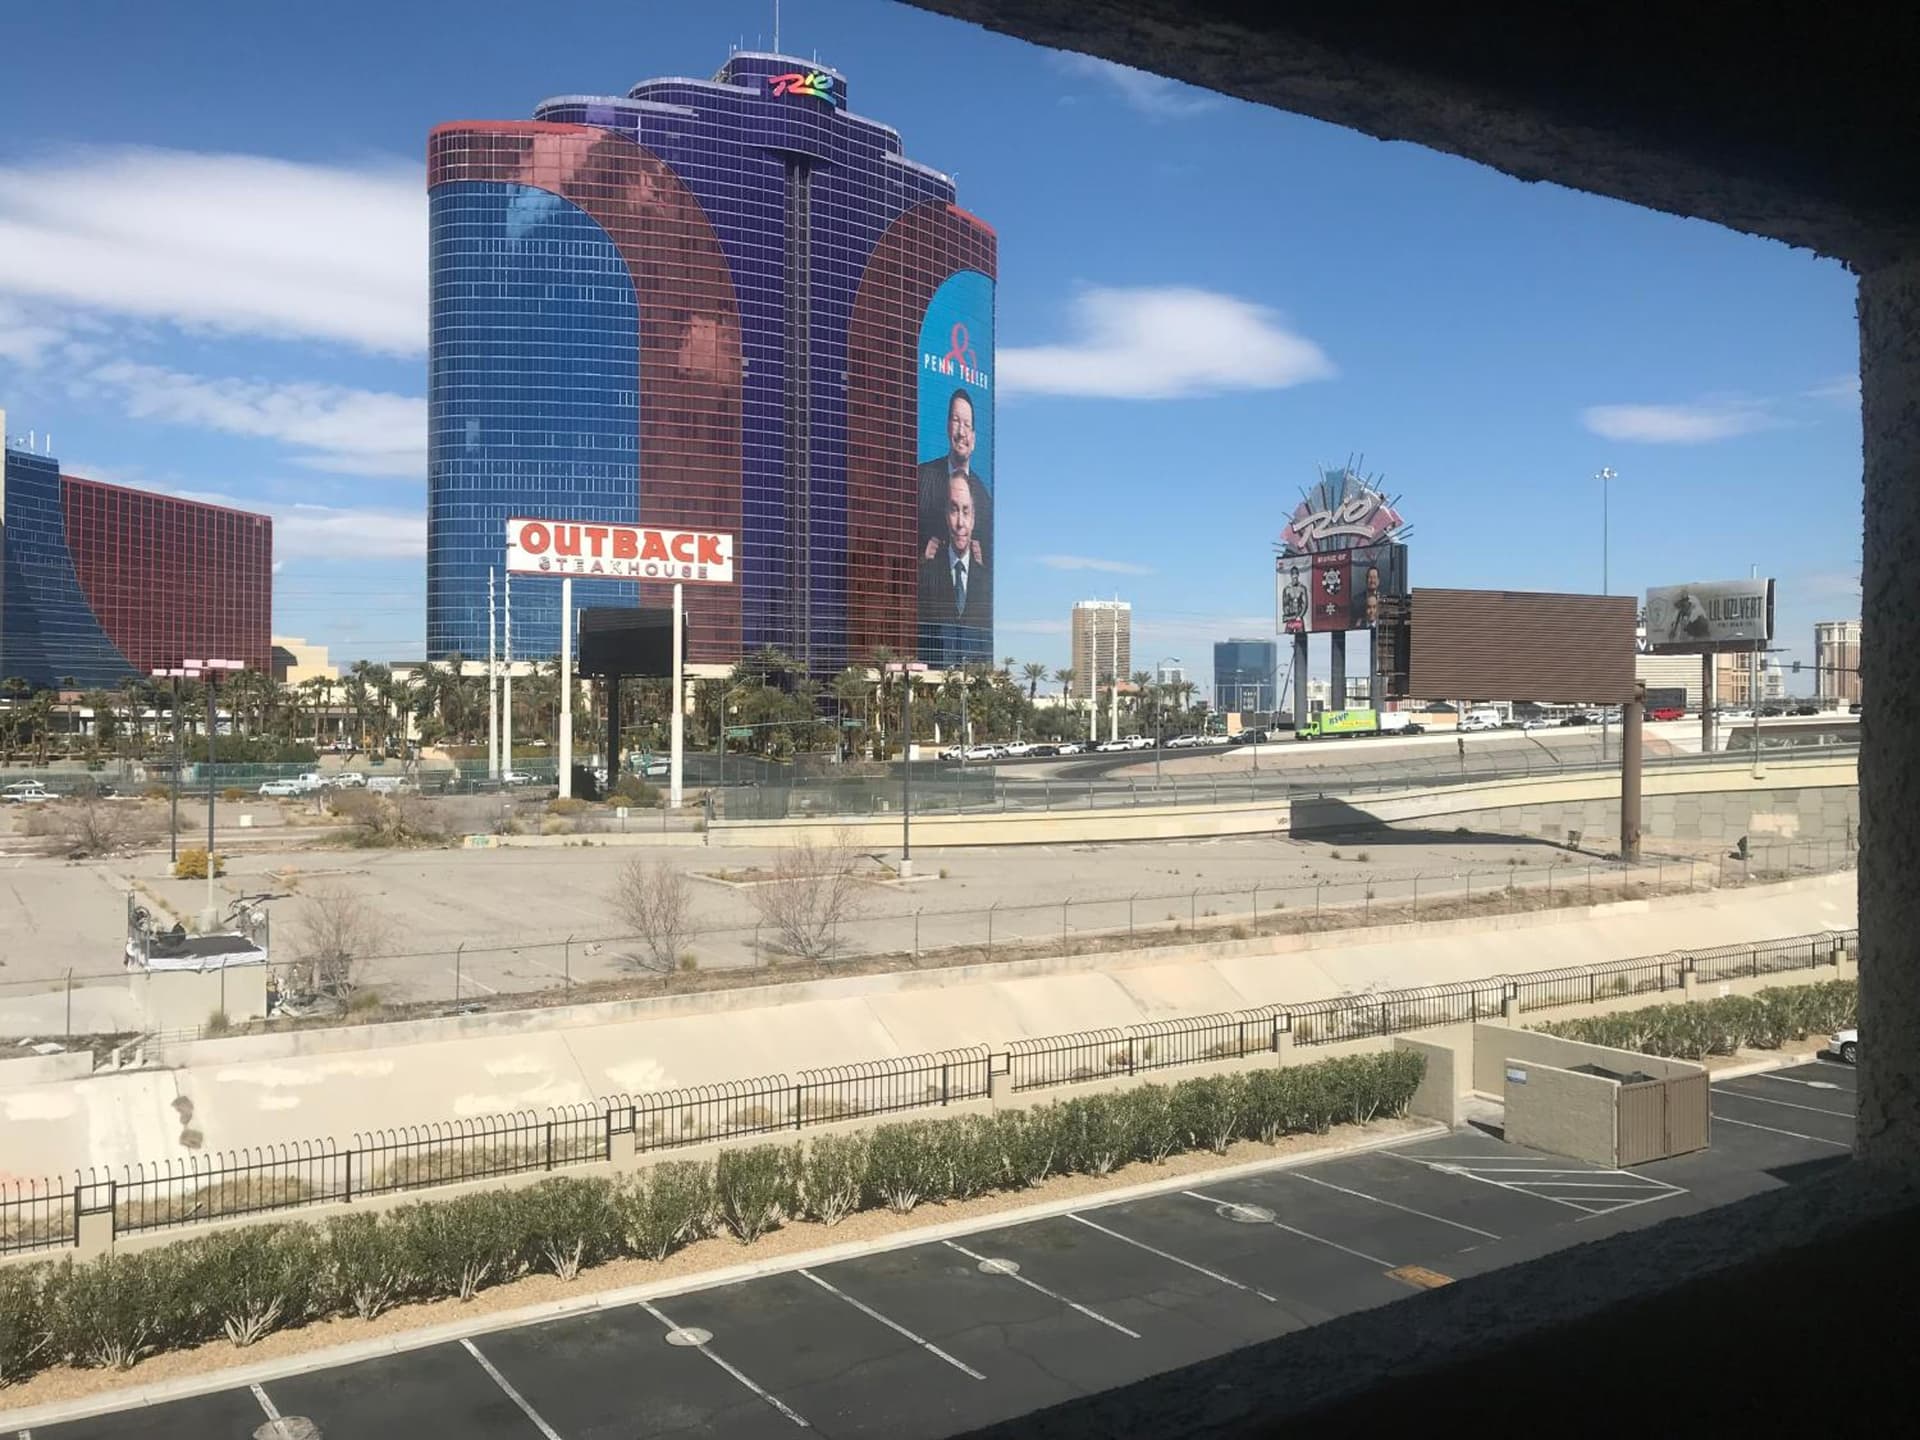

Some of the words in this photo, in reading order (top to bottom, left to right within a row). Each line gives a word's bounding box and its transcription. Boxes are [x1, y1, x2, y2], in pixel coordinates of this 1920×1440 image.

[924, 353, 955, 376] PENN
[1293, 495, 1374, 548] Rio
[519, 522, 724, 565] OUTBACK
[538, 556, 708, 579] STEAKHOUSE
[1709, 599, 1722, 620] LIL
[1739, 596, 1762, 619] VERT
